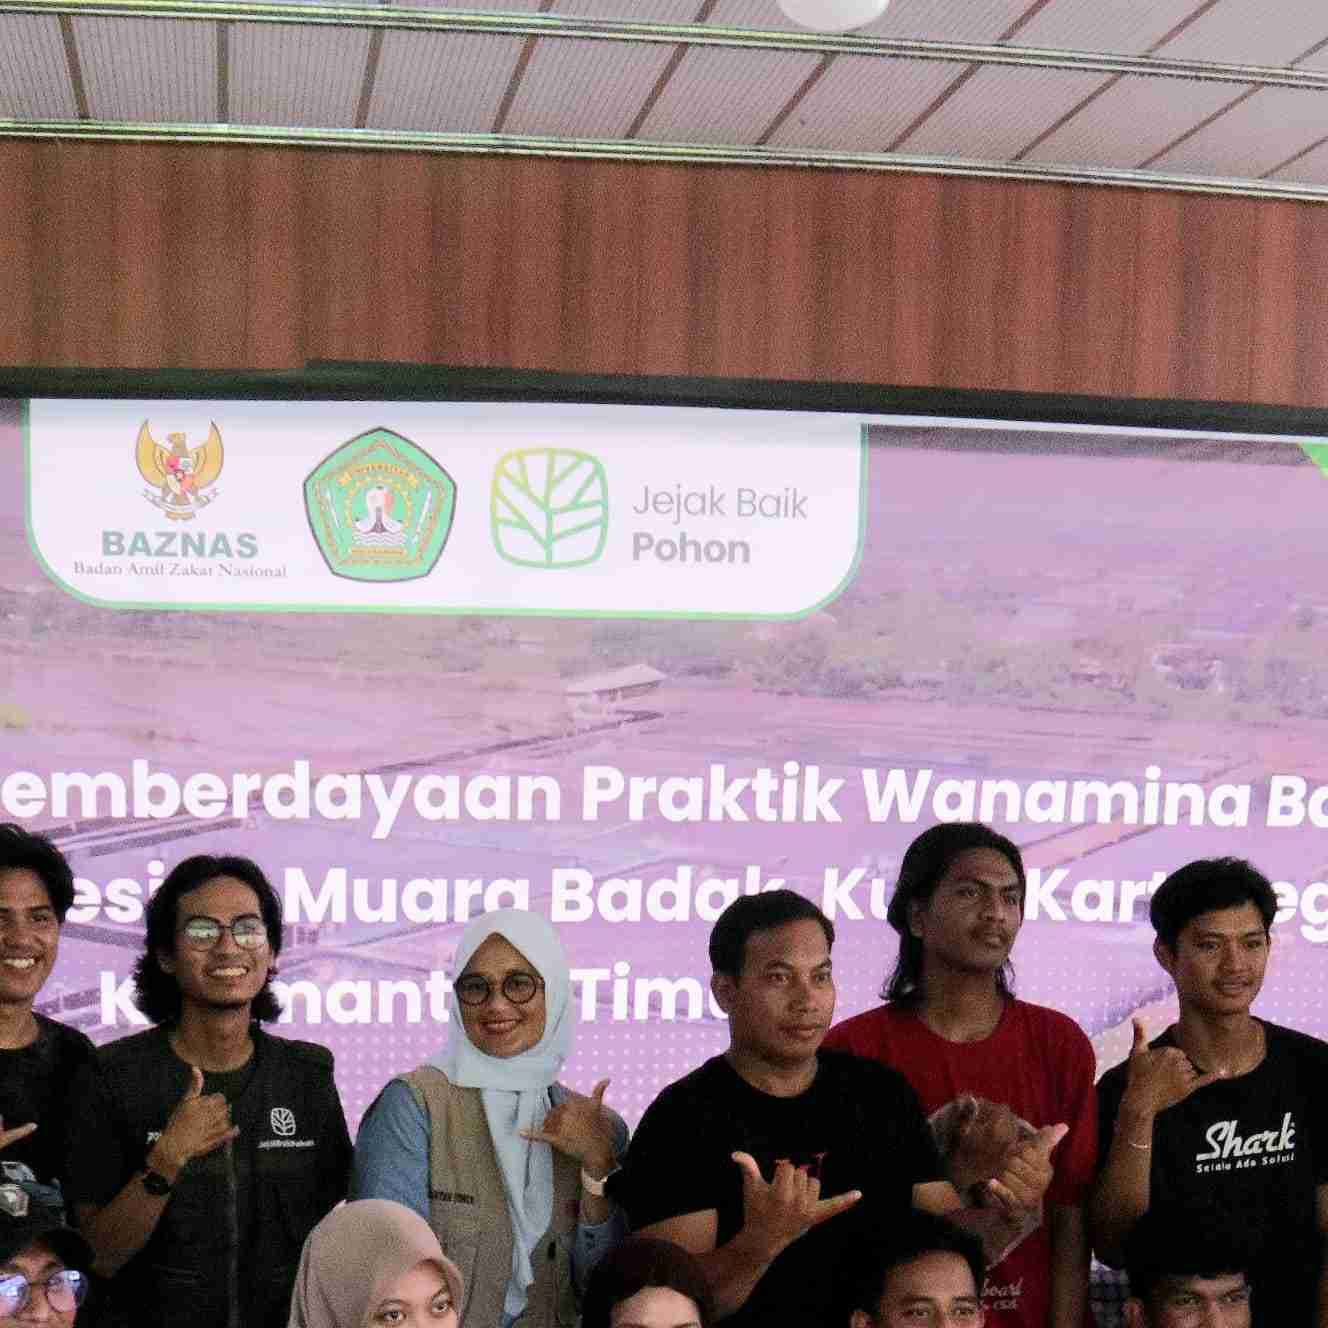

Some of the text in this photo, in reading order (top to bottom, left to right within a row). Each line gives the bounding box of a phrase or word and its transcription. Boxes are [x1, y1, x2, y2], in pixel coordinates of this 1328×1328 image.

[632, 483, 808, 525] Jejak Baik
[101, 530, 259, 559] BAZNAS
[632, 531, 751, 563] Pohon
[73, 561, 121, 576] Badan
[127, 562, 165, 576] Amil
[218, 563, 287, 578] Nasional
[582, 761, 846, 823] Praktik
[862, 765, 1252, 827] Wanamina
[1196, 1112, 1295, 1161] Shark
